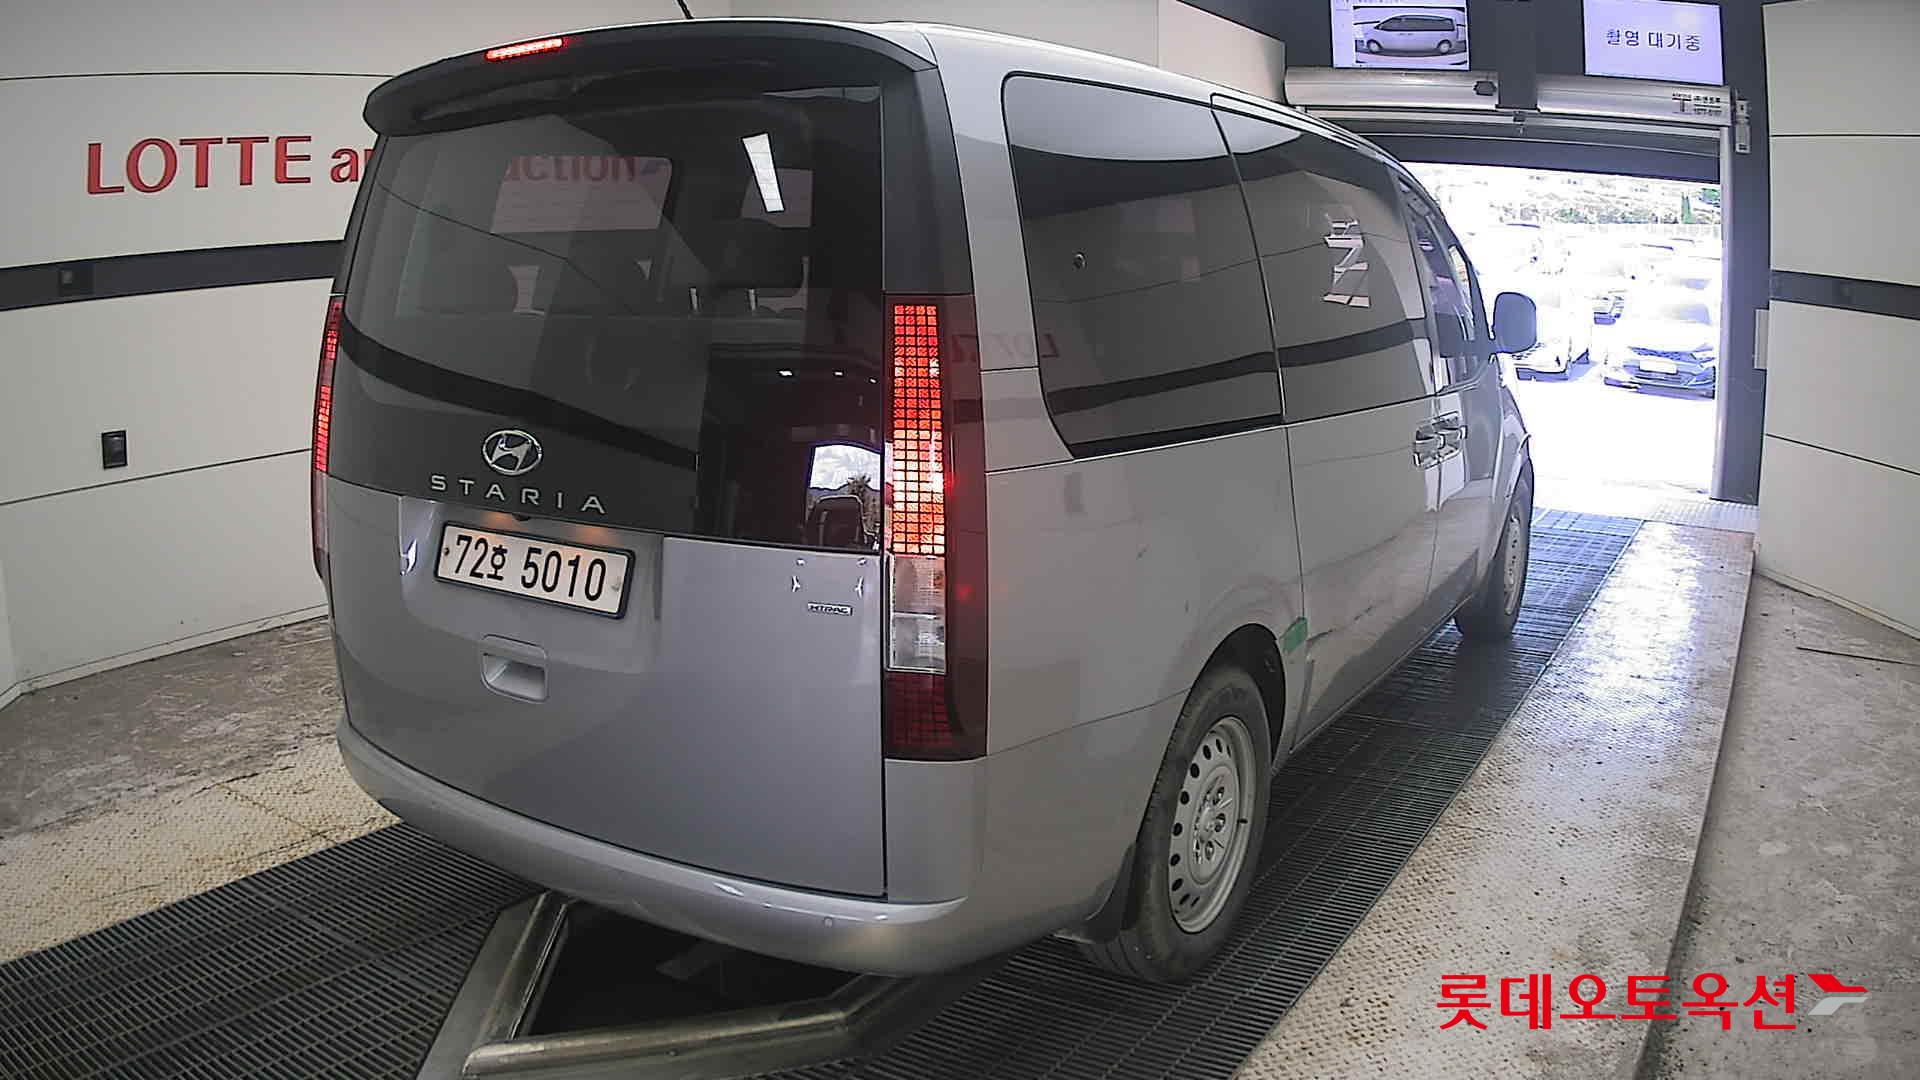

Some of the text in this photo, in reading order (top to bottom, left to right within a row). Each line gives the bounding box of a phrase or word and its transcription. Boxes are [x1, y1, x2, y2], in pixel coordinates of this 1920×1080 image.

[1648, 32, 1700, 51] 대기중
[88, 135, 312, 195] LOTTE
[331, 148, 375, 183] a
[430, 474, 606, 515] STARIA
[454, 533, 607, 602] 72호 5010
